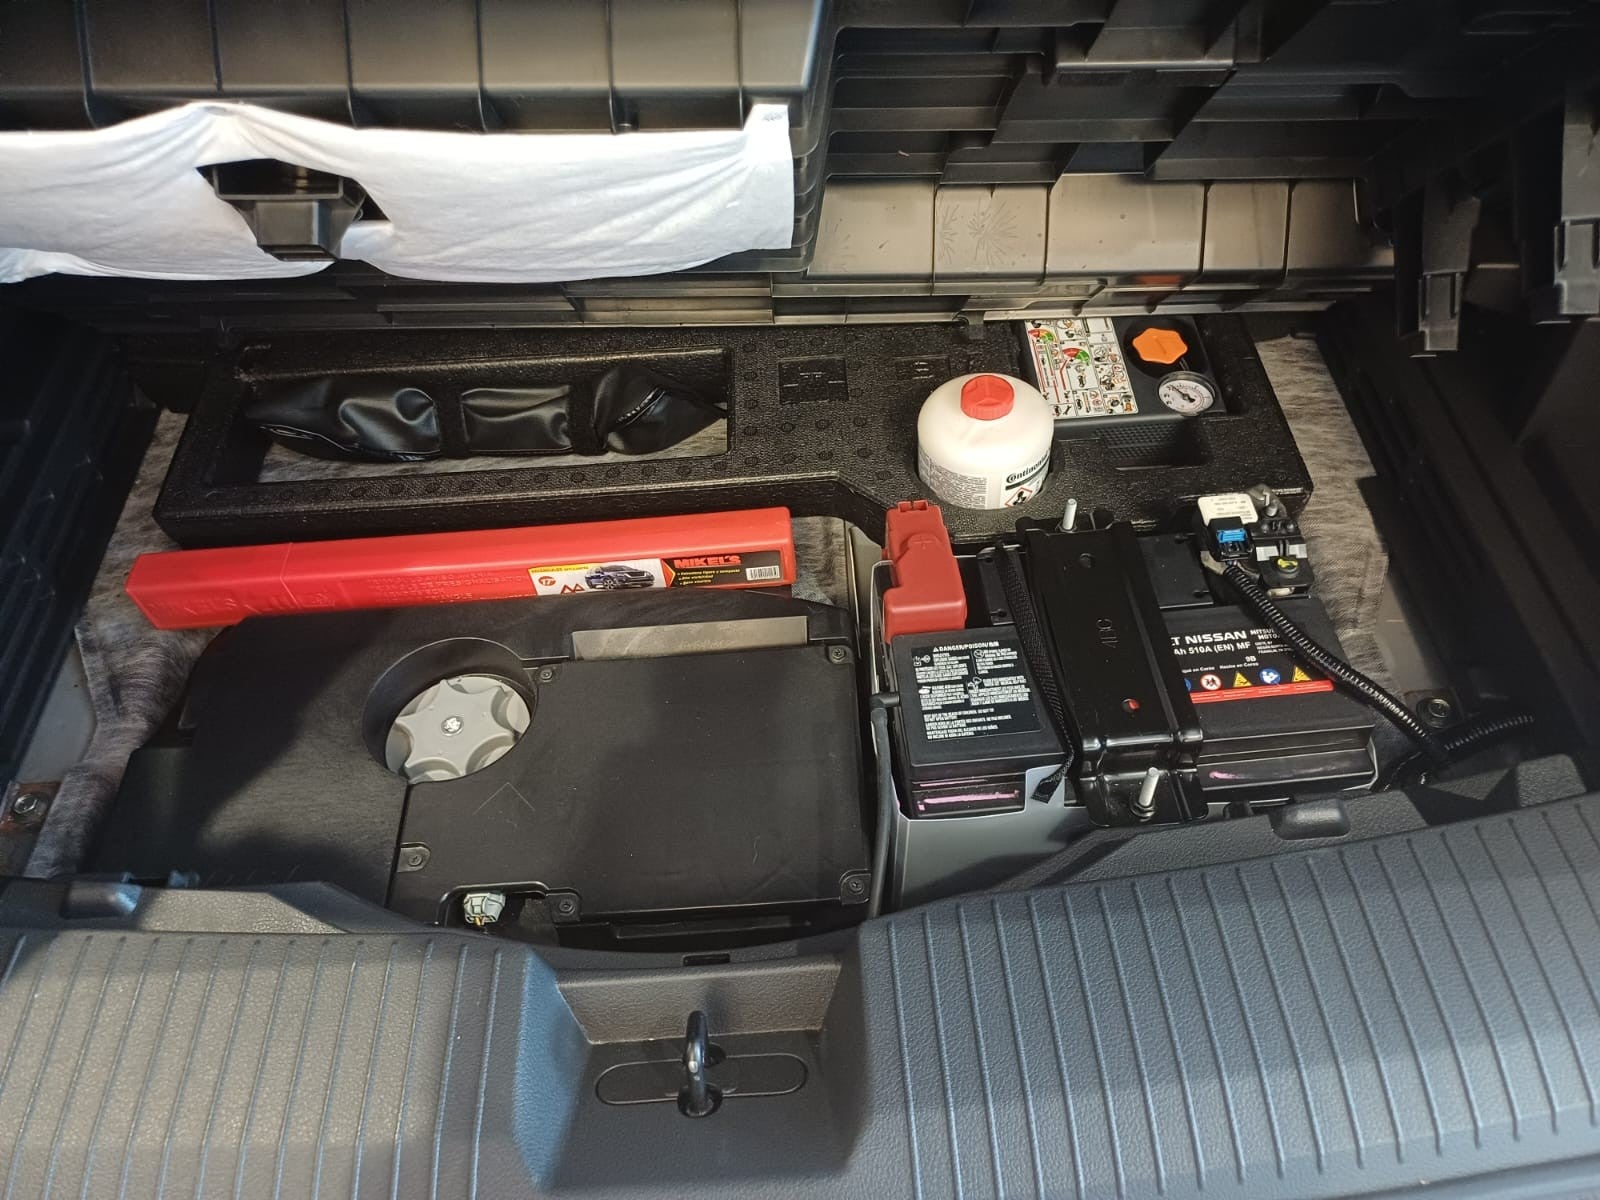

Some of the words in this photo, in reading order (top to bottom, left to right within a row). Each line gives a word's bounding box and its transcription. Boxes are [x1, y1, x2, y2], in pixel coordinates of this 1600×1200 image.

[673, 555, 741, 569] MIKEL'S
[1171, 636, 1181, 646] T
[1184, 631, 1247, 645] NISSAN
[1188, 645, 1213, 654] 510A
[1213, 643, 1235, 653] (EN)
[1236, 641, 1251, 650] MF
